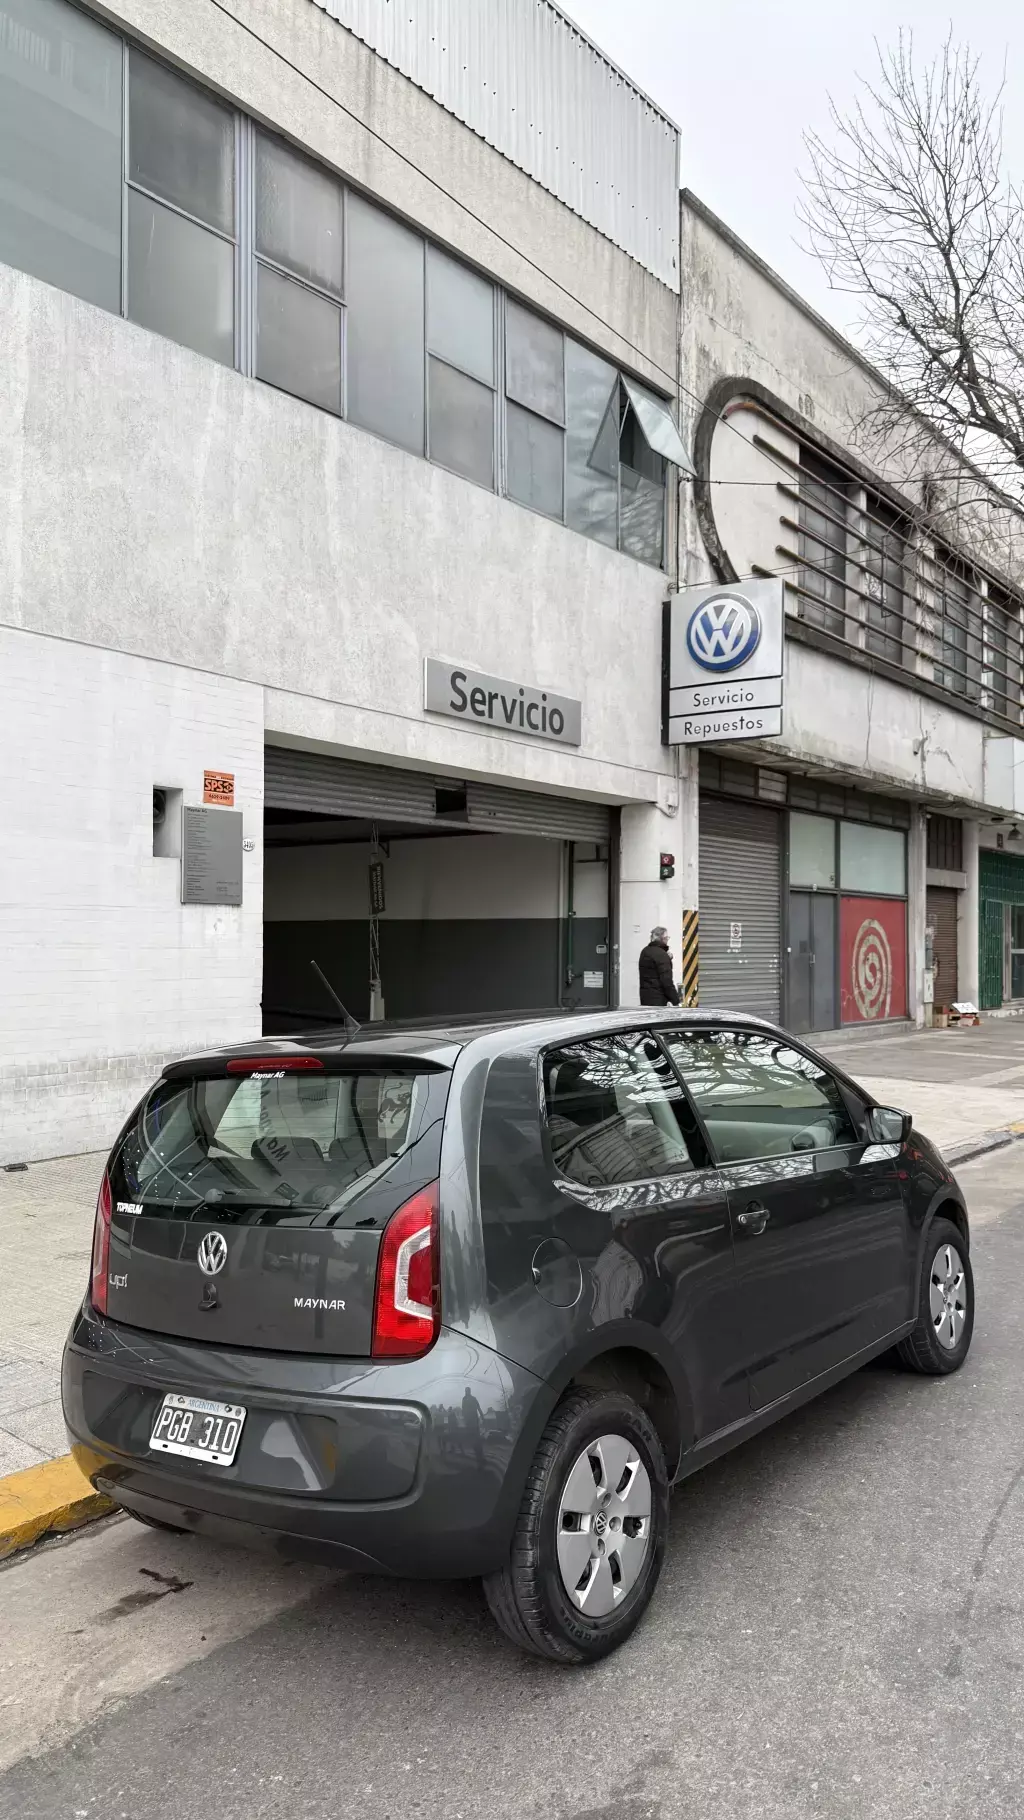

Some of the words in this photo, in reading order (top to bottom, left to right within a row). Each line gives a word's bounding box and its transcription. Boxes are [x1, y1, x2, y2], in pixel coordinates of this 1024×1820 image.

[449, 670, 565, 736] Servicio
[692, 688, 755, 708] Servicio
[683, 715, 764, 737] Repuestos
[205, 779, 224, 792] SPS
[250, 1071, 274, 1080] Maynar
[273, 1071, 286, 1079] AG
[109, 1273, 128, 1290] up!
[294, 1297, 346, 1311] MAYNAR
[188, 1399, 221, 1412] ARGENTINA
[156, 1408, 193, 1442] PGB
[198, 1417, 238, 1452] 310
